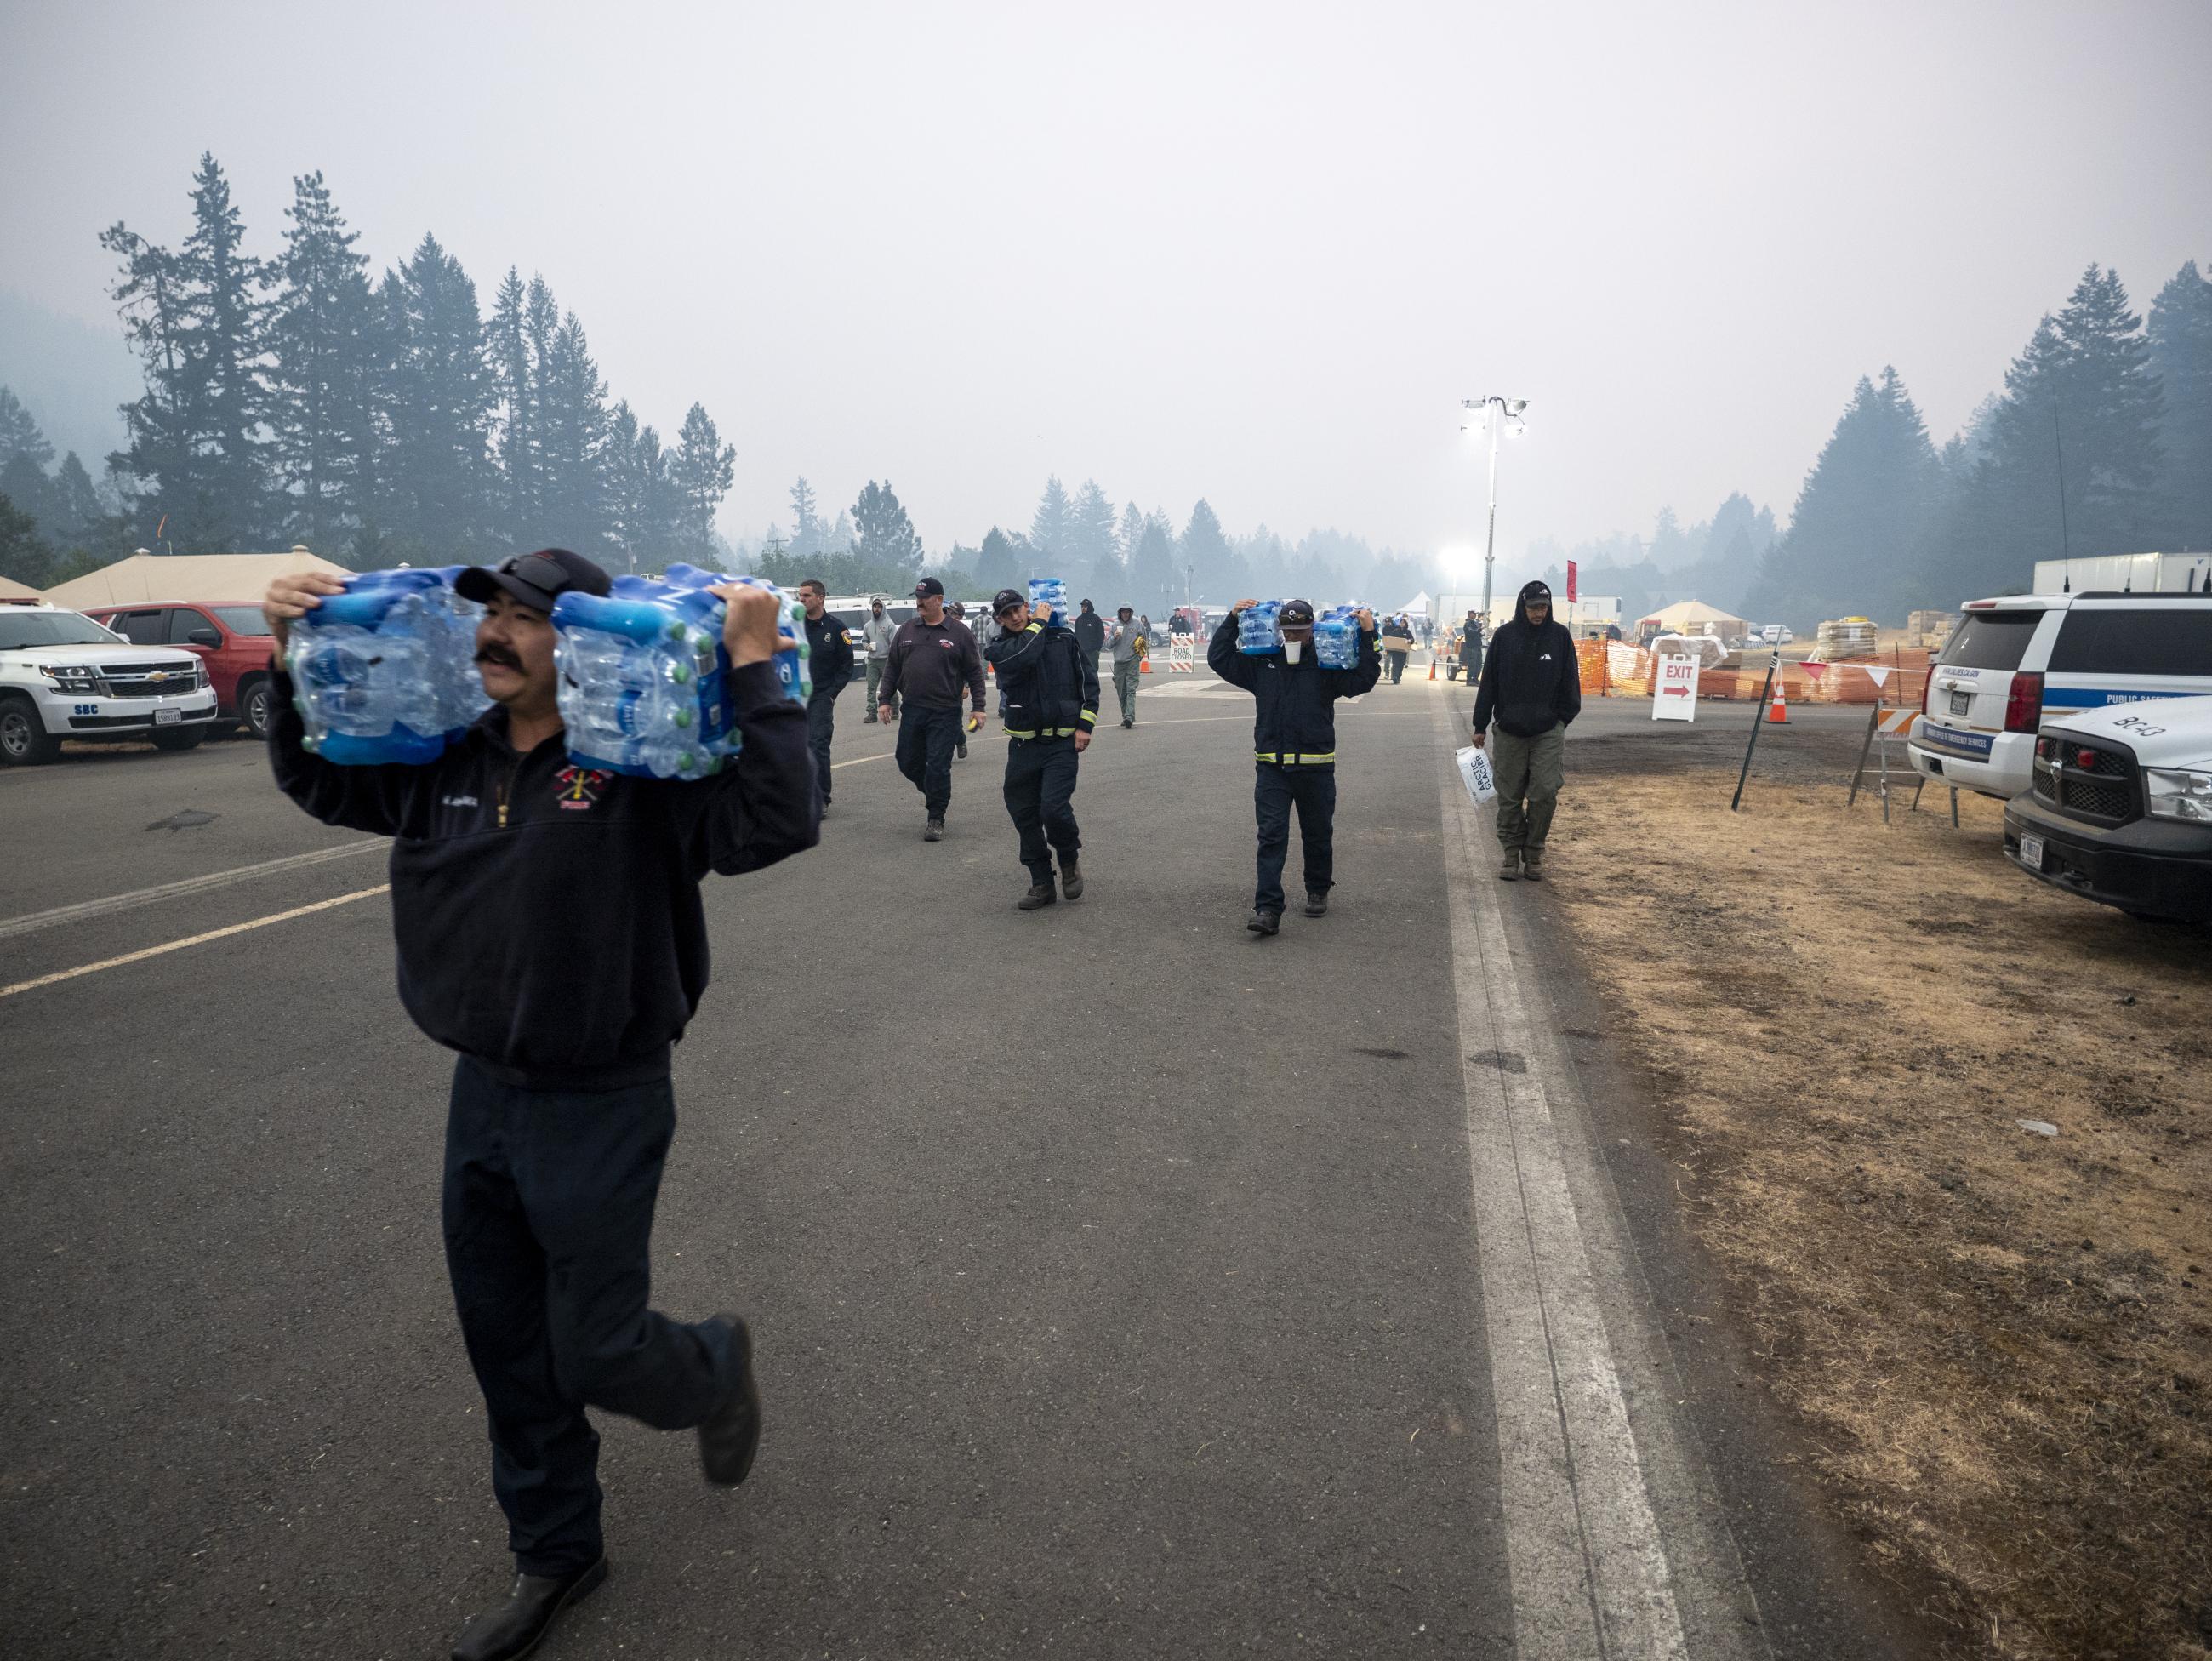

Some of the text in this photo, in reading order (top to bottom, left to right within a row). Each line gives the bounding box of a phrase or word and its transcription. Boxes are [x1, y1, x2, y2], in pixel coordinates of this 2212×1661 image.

[1666, 665, 1693, 679] EXIT
[2107, 694, 2138, 704] PUBLIC
[74, 704, 99, 715] SBC
[2112, 716, 2167, 737] BC43
[1968, 737, 1987, 749] SERVICES
[1471, 760, 1485, 791] ARCTIC
[1475, 754, 1491, 790] GLACIER
